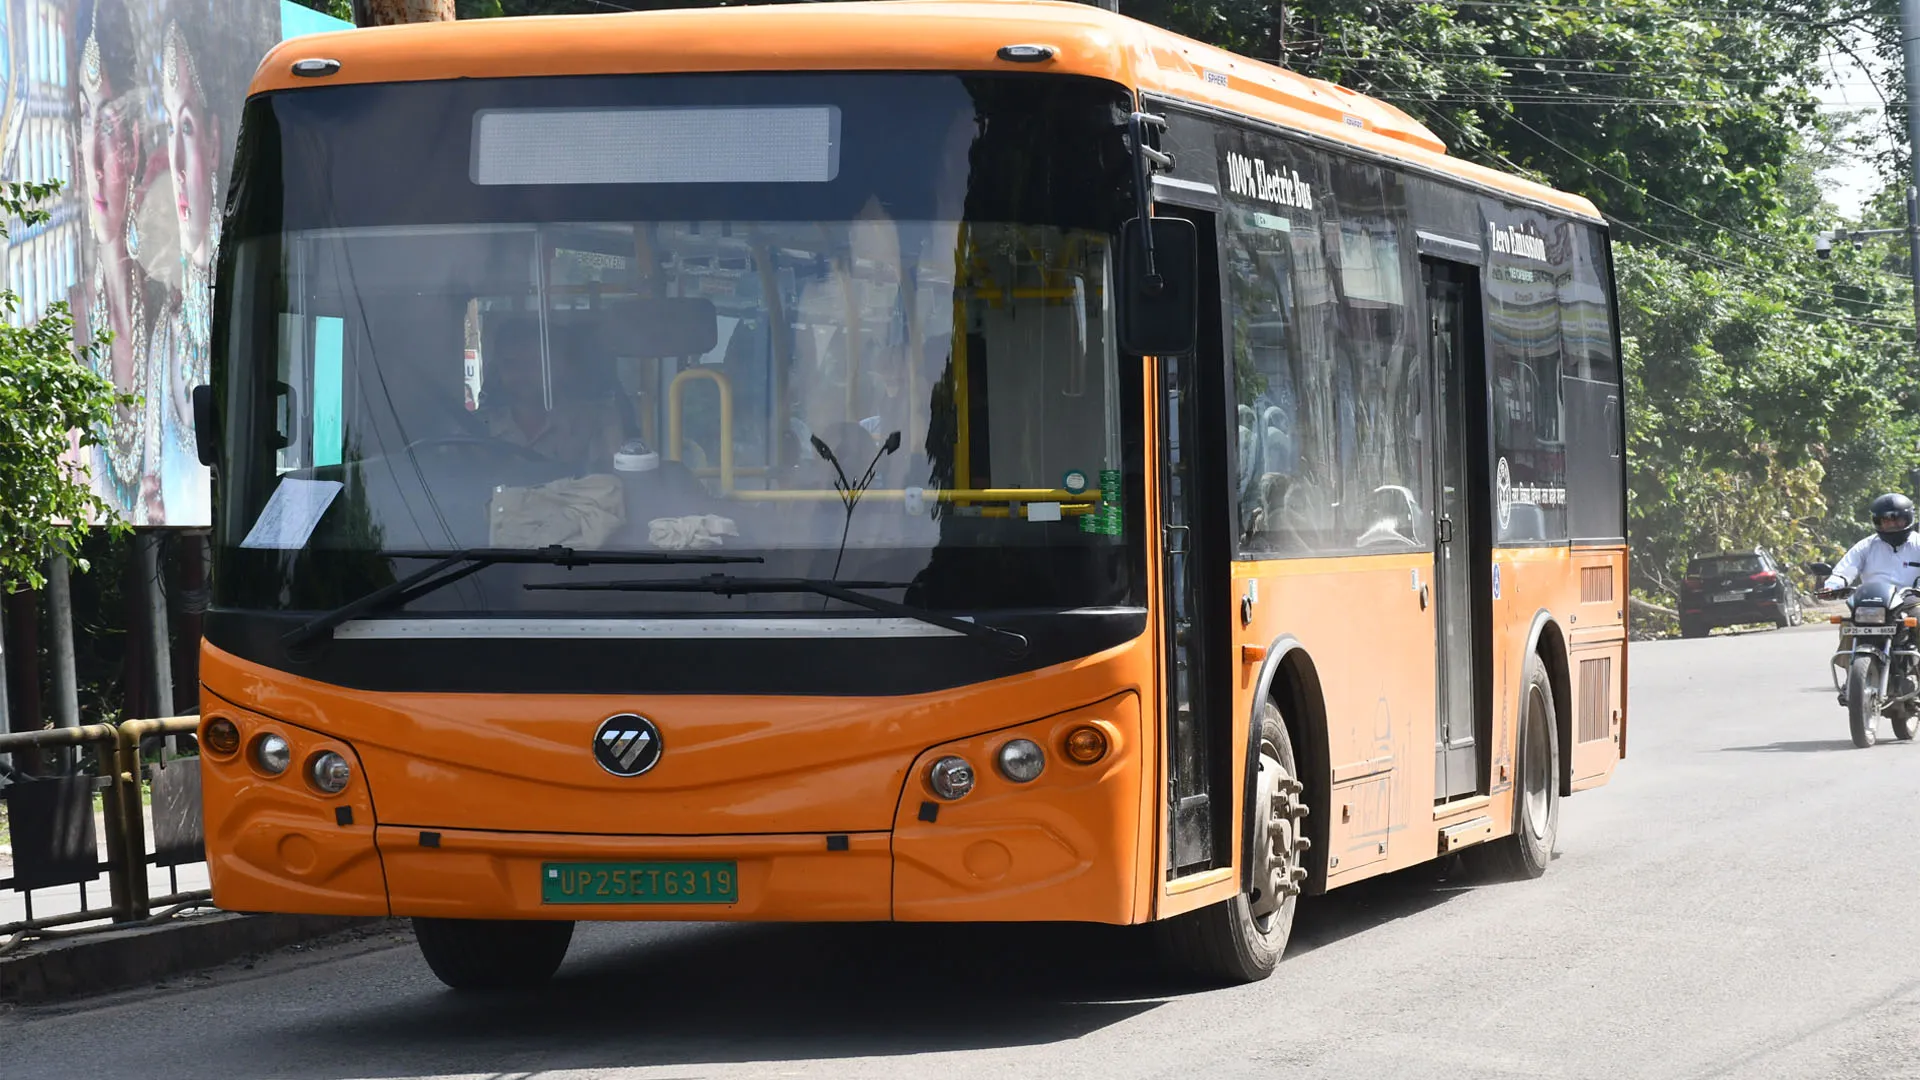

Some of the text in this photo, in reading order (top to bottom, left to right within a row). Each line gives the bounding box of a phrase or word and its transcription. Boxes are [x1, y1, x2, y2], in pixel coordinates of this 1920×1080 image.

[1227, 151, 1312, 210] 100% Electric Bus
[1490, 221, 1547, 262] Zero Emission
[561, 870, 731, 895] UP25ET6319
